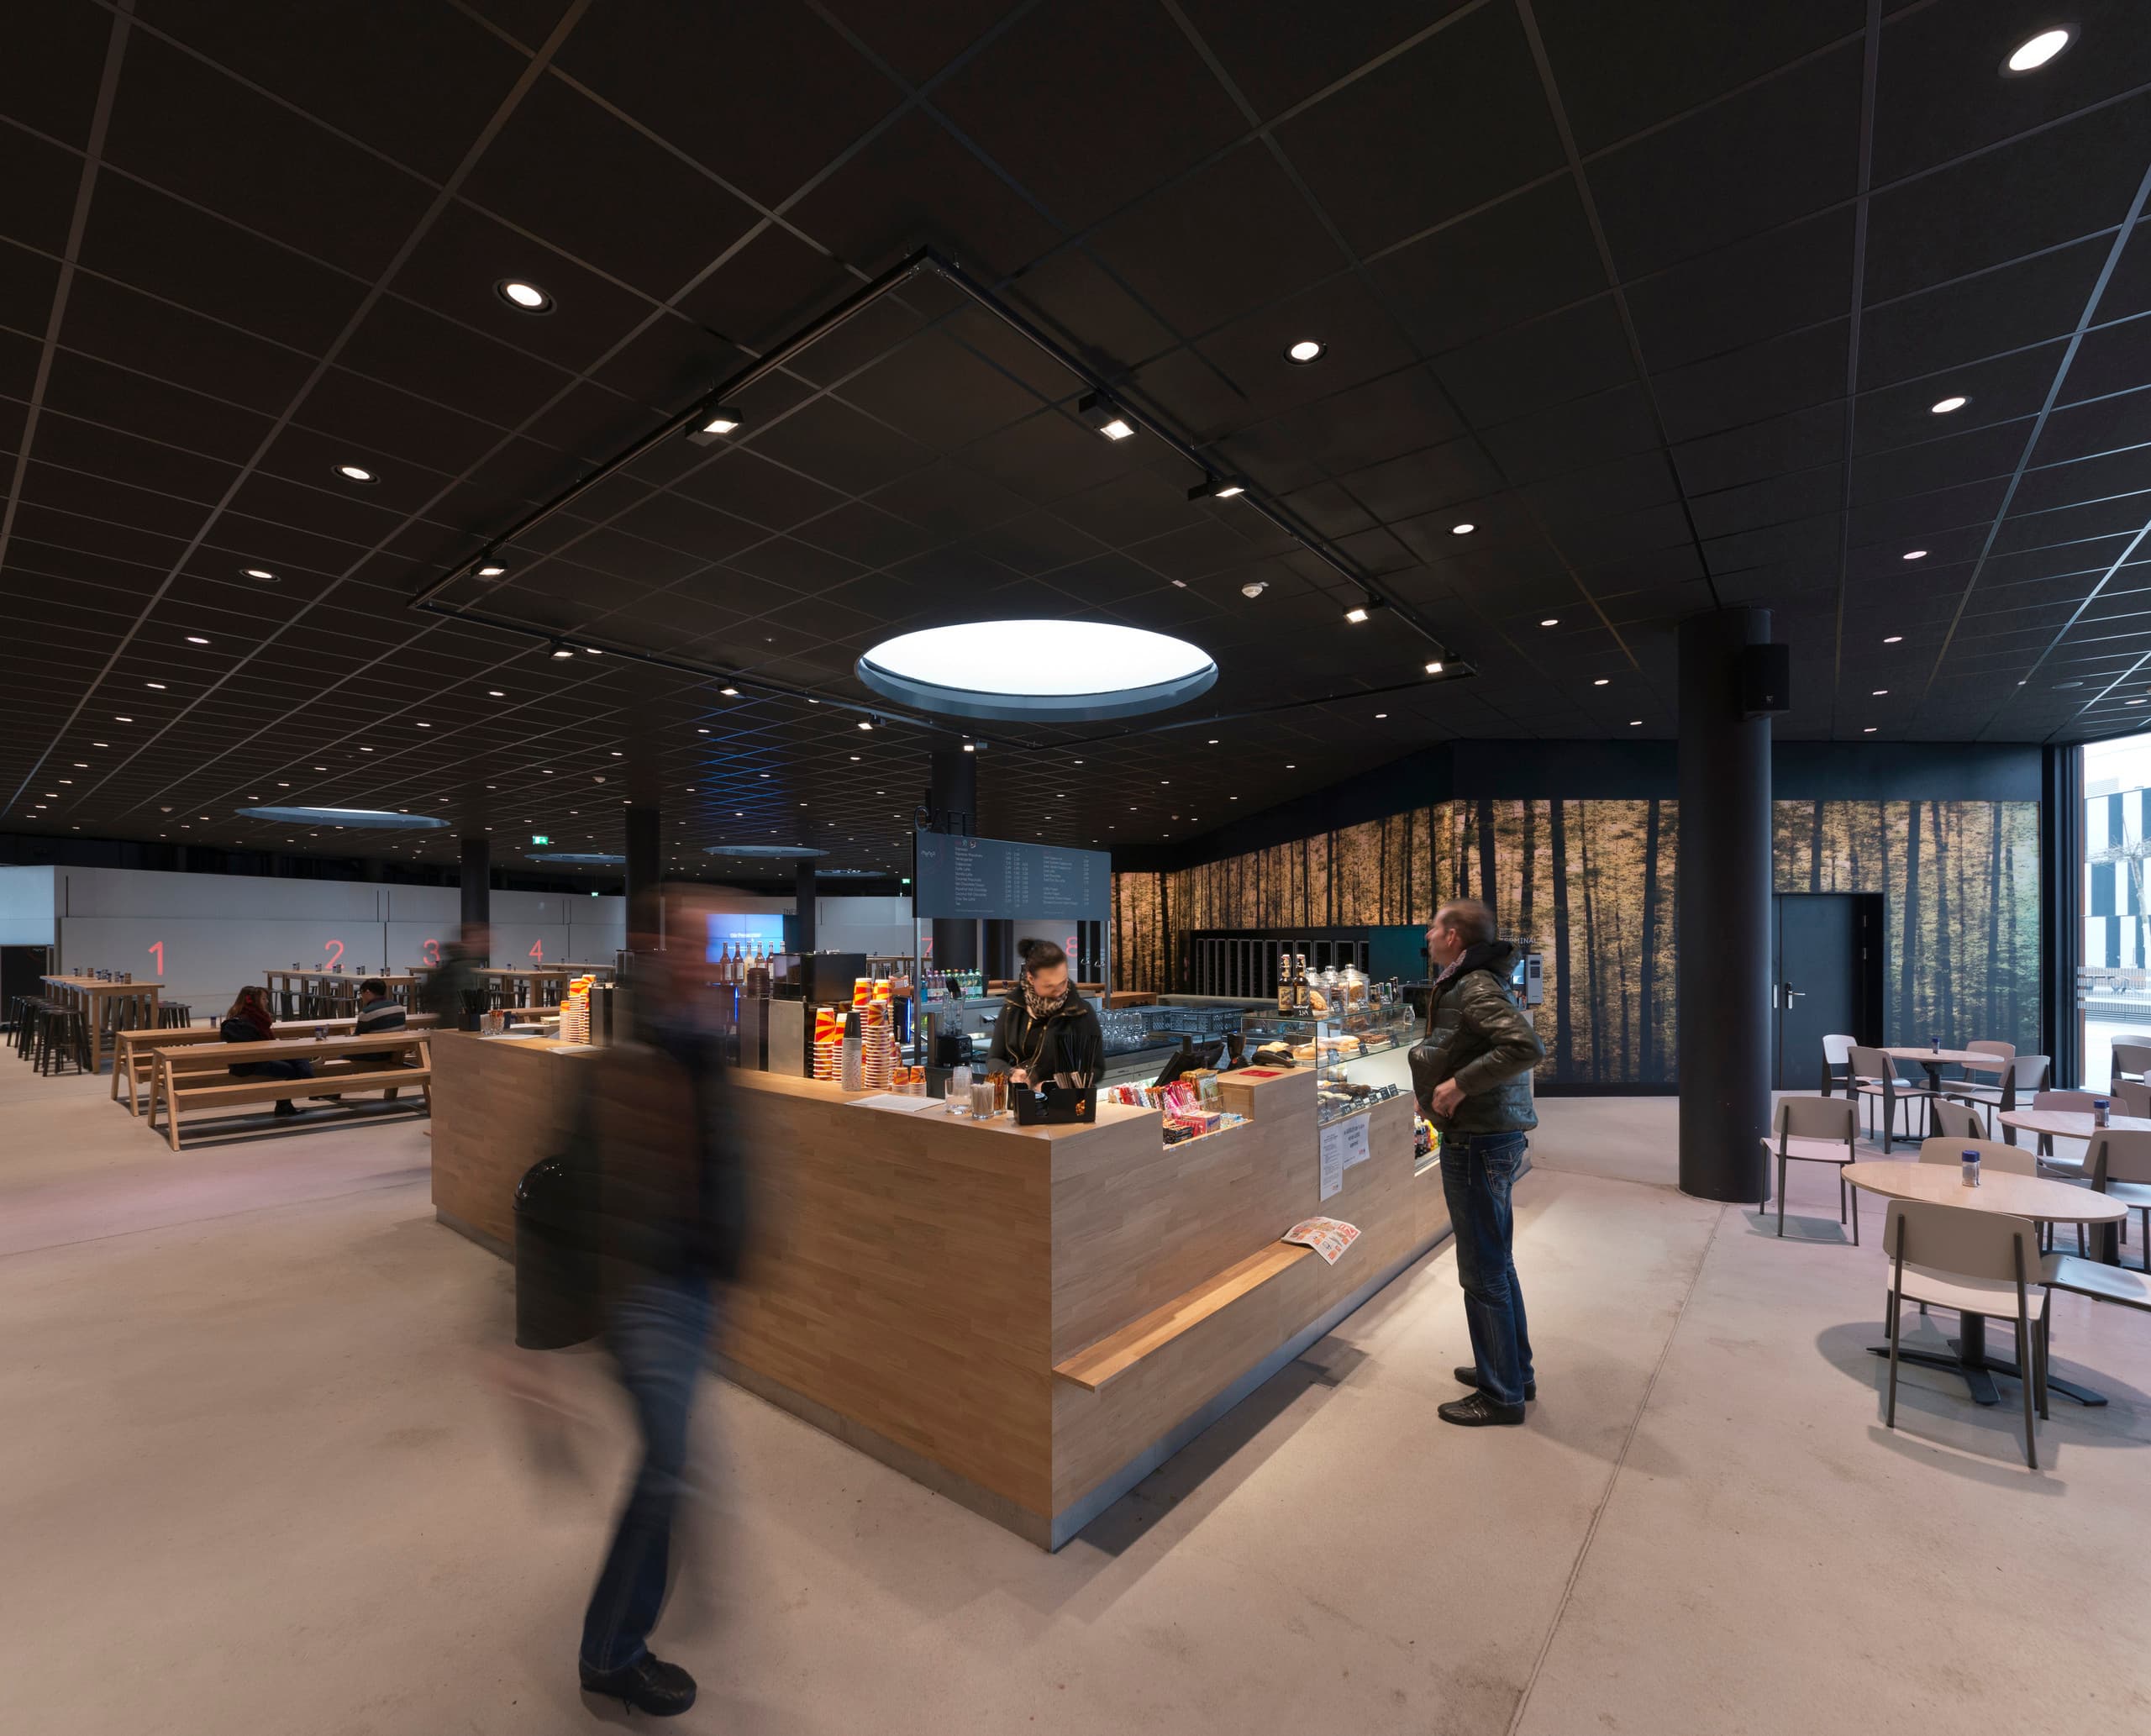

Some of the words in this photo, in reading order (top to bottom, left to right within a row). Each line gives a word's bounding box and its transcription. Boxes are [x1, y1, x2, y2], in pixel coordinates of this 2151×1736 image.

[148, 940, 164, 976] 1
[324, 939, 344, 970] 2
[423, 939, 440, 967] 3
[529, 939, 544, 963] 4
[921, 937, 934, 958] 7
[1065, 936, 1078, 957] 8
